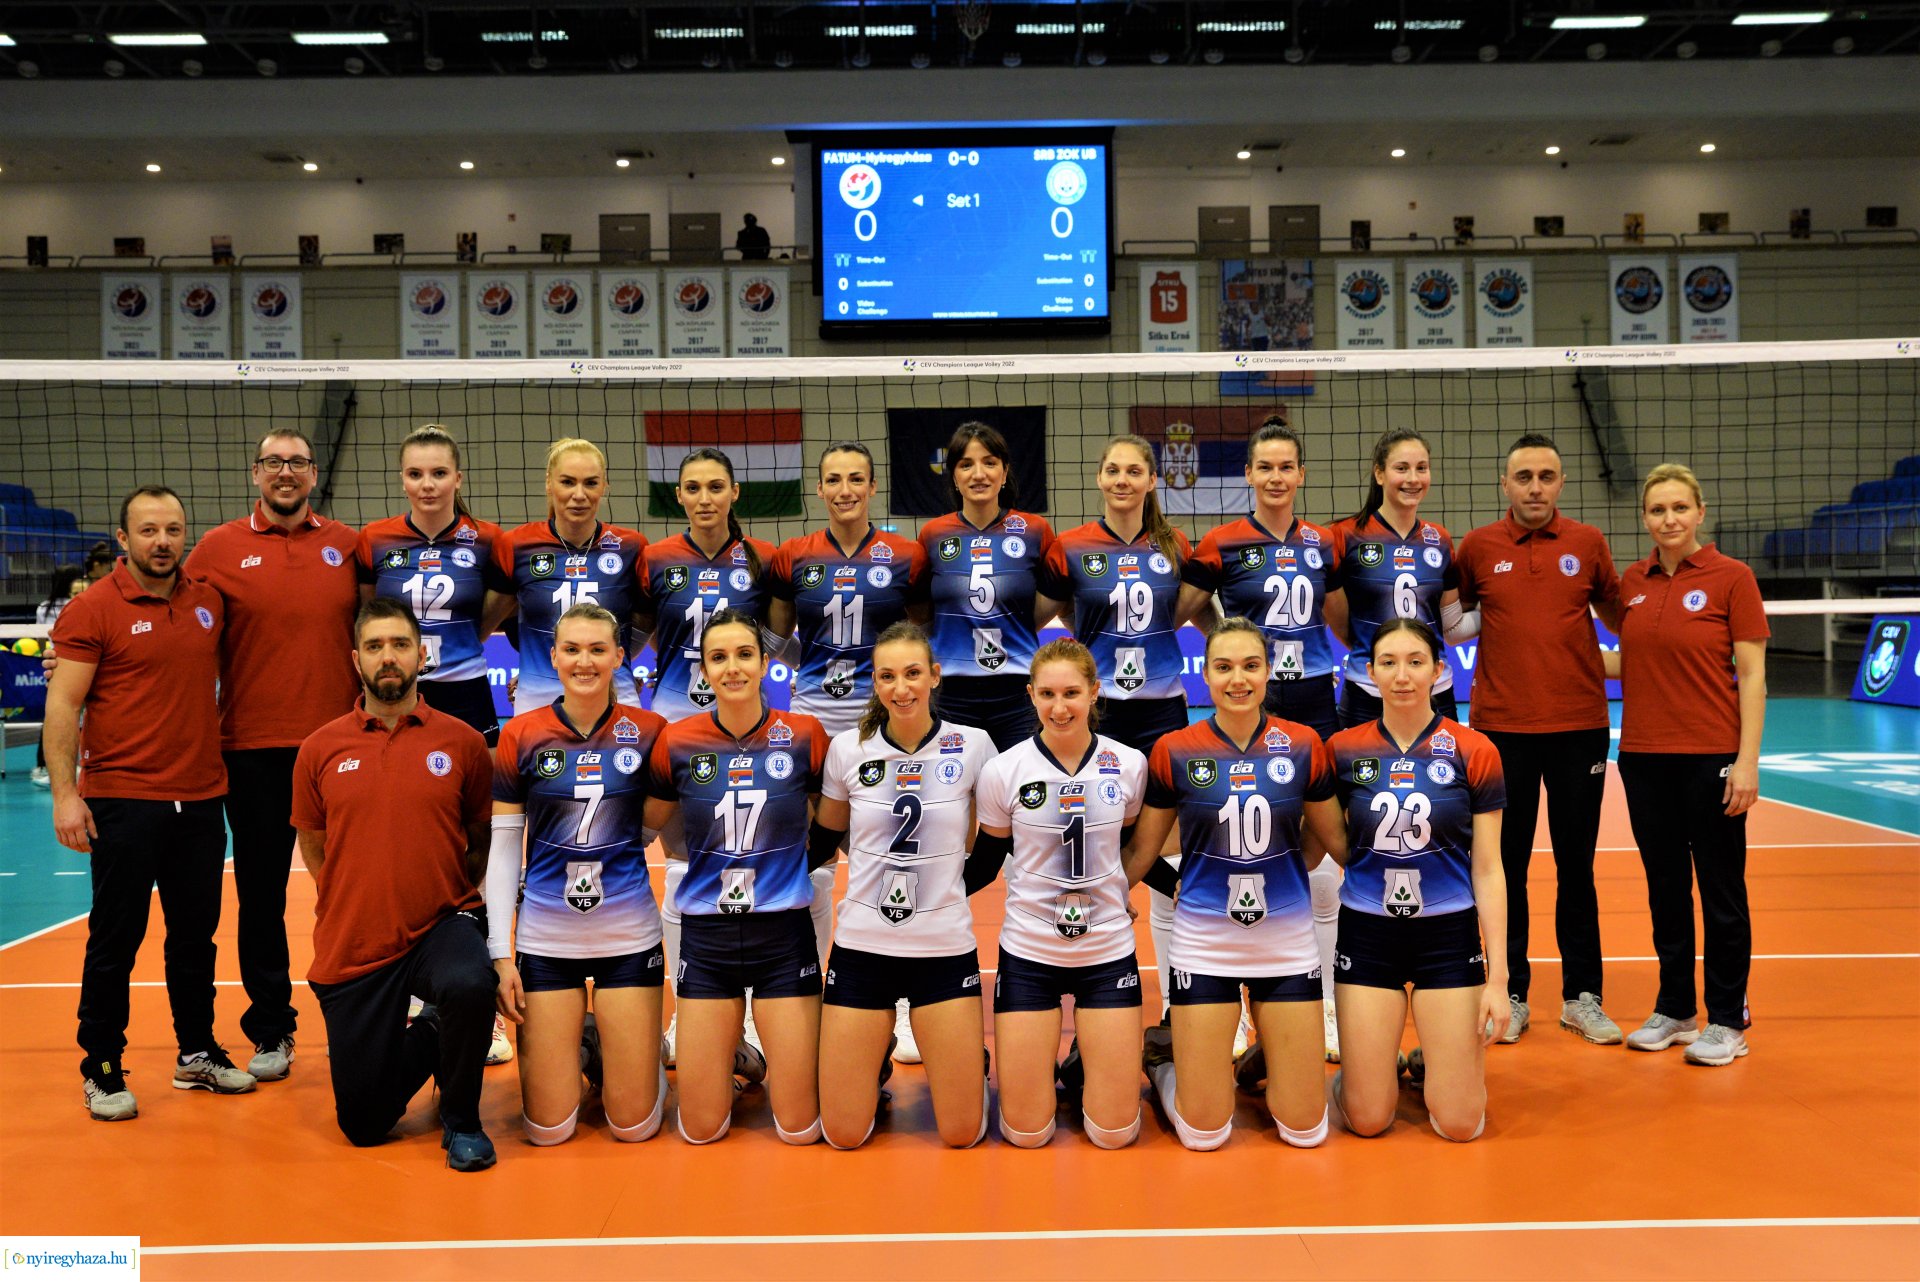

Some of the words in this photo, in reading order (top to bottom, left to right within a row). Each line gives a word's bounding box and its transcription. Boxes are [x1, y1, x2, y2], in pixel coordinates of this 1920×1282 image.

[1033, 149, 1055, 161] SRB
[1056, 148, 1080, 161] ZOK
[1081, 148, 1097, 161] UB
[947, 193, 972, 208] Set
[974, 193, 980, 207] 1
[854, 209, 877, 241] 0
[1051, 206, 1074, 238] 0
[838, 277, 849, 291] 0
[1084, 273, 1095, 287] 0
[838, 301, 849, 315] 0
[1084, 297, 1095, 311] 0
[1159, 290, 1179, 312] 15
[752, 337, 768, 345] 2017
[969, 564, 996, 614] 5
[1393, 572, 1418, 620] 6
[402, 573, 455, 621] 12
[552, 581, 599, 617] 15
[1263, 574, 1314, 626] 20
[1109, 581, 1154, 633] 19
[823, 594, 864, 646] 11
[1881, 626, 1901, 638] CEV
[986, 658, 999, 666] УБ
[1123, 680, 1136, 688] УБ
[1282, 673, 1295, 681] УБ
[831, 687, 844, 695] УБ
[697, 695, 709, 703] УБ
[573, 784, 605, 845] 7
[714, 789, 767, 851] 17
[1370, 791, 1432, 851] 23
[889, 793, 923, 855] 2
[1218, 794, 1272, 857] 10
[1062, 815, 1085, 878] 1
[577, 899, 592, 908] УБ
[728, 905, 742, 914] УБ
[889, 908, 904, 918] УБ
[1240, 913, 1255, 922] УБ
[1396, 907, 1411, 916] УБ
[1066, 926, 1080, 936] УБ
